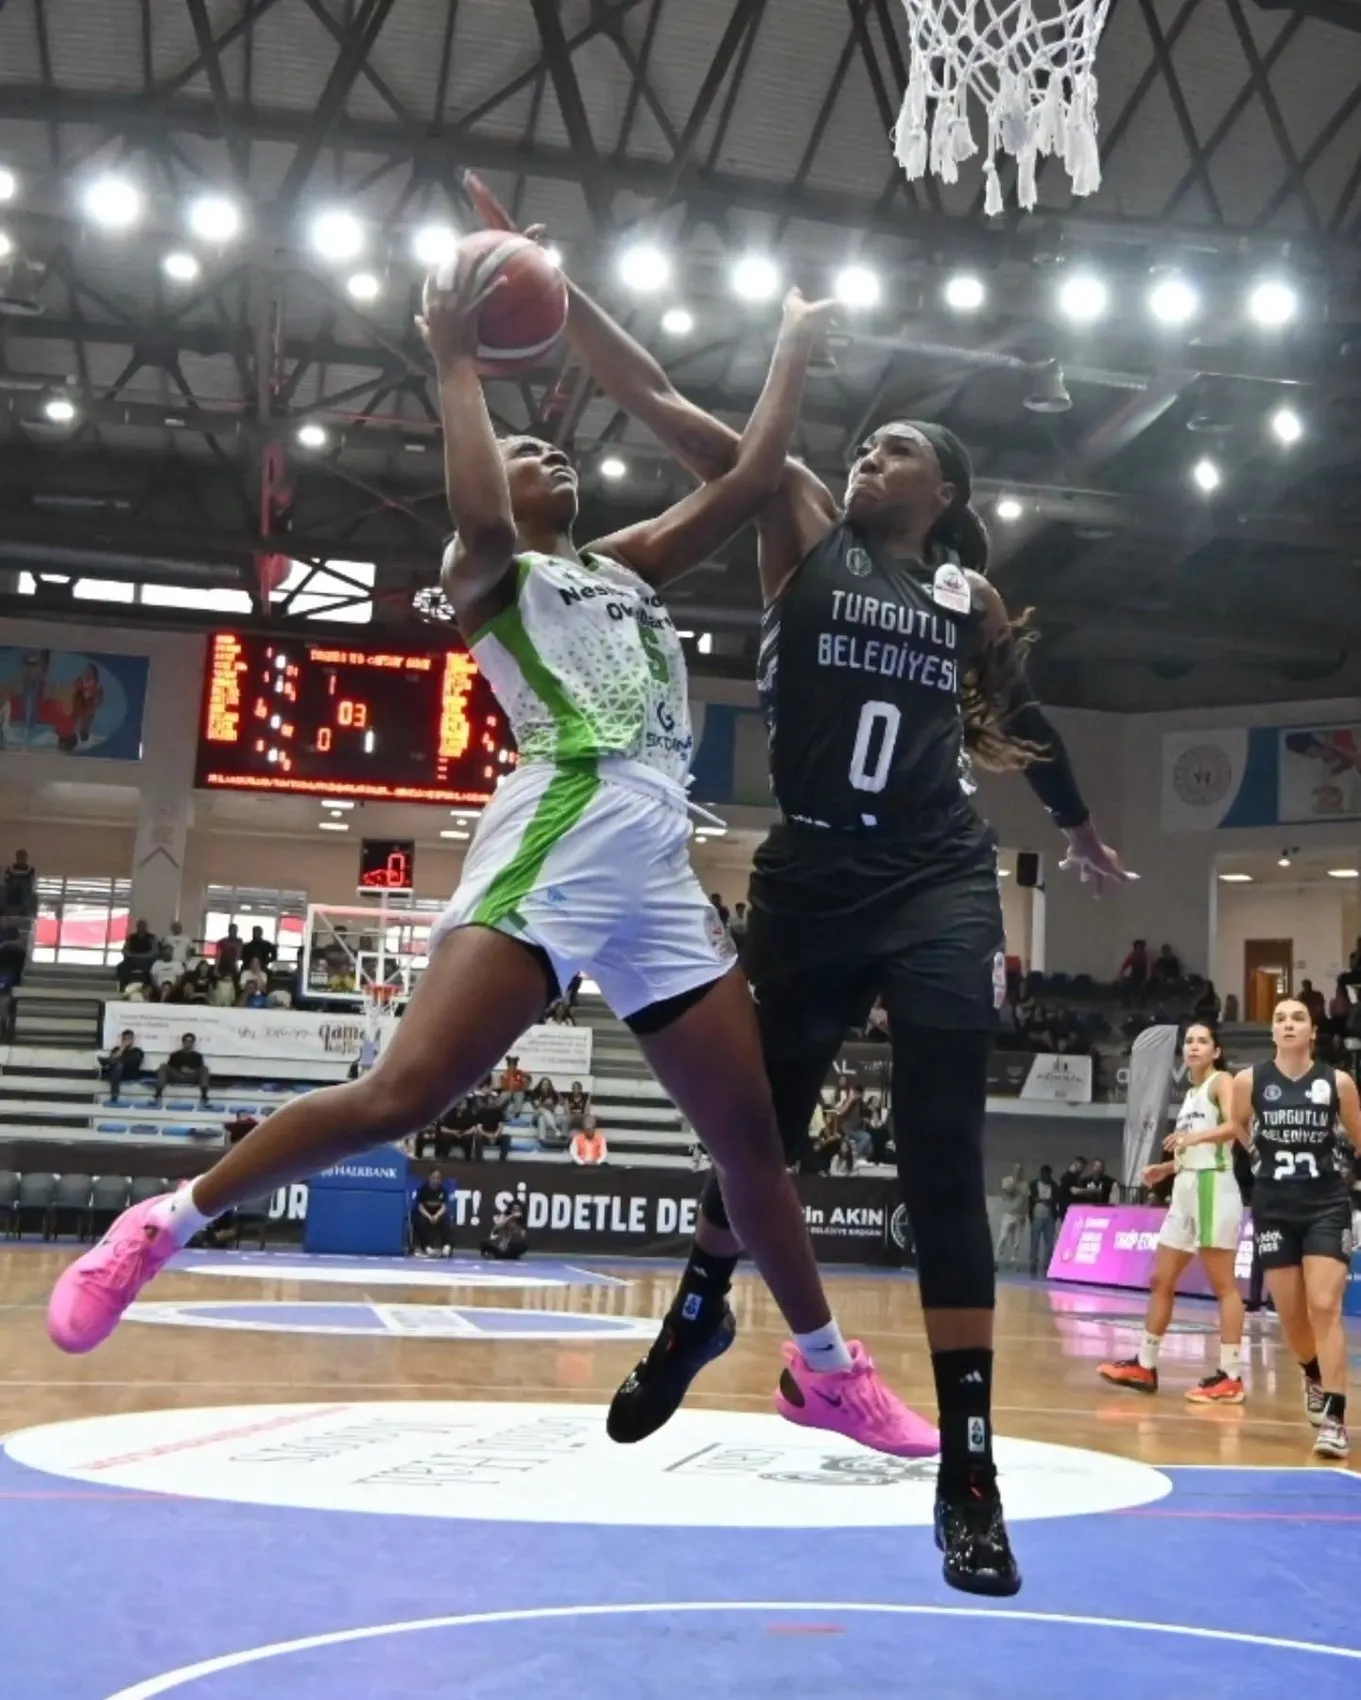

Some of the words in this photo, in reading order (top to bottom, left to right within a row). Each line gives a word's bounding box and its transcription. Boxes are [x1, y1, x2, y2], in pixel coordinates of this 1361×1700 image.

[832, 589, 957, 650] TURGUTLU
[338, 700, 367, 727] 03
[316, 727, 332, 752] 0
[849, 700, 901, 792] 0
[1263, 1109, 1329, 1127] TURGUTLU
[335, 1164, 398, 1180] HALKBANK
[829, 1207, 884, 1226] AKIN
